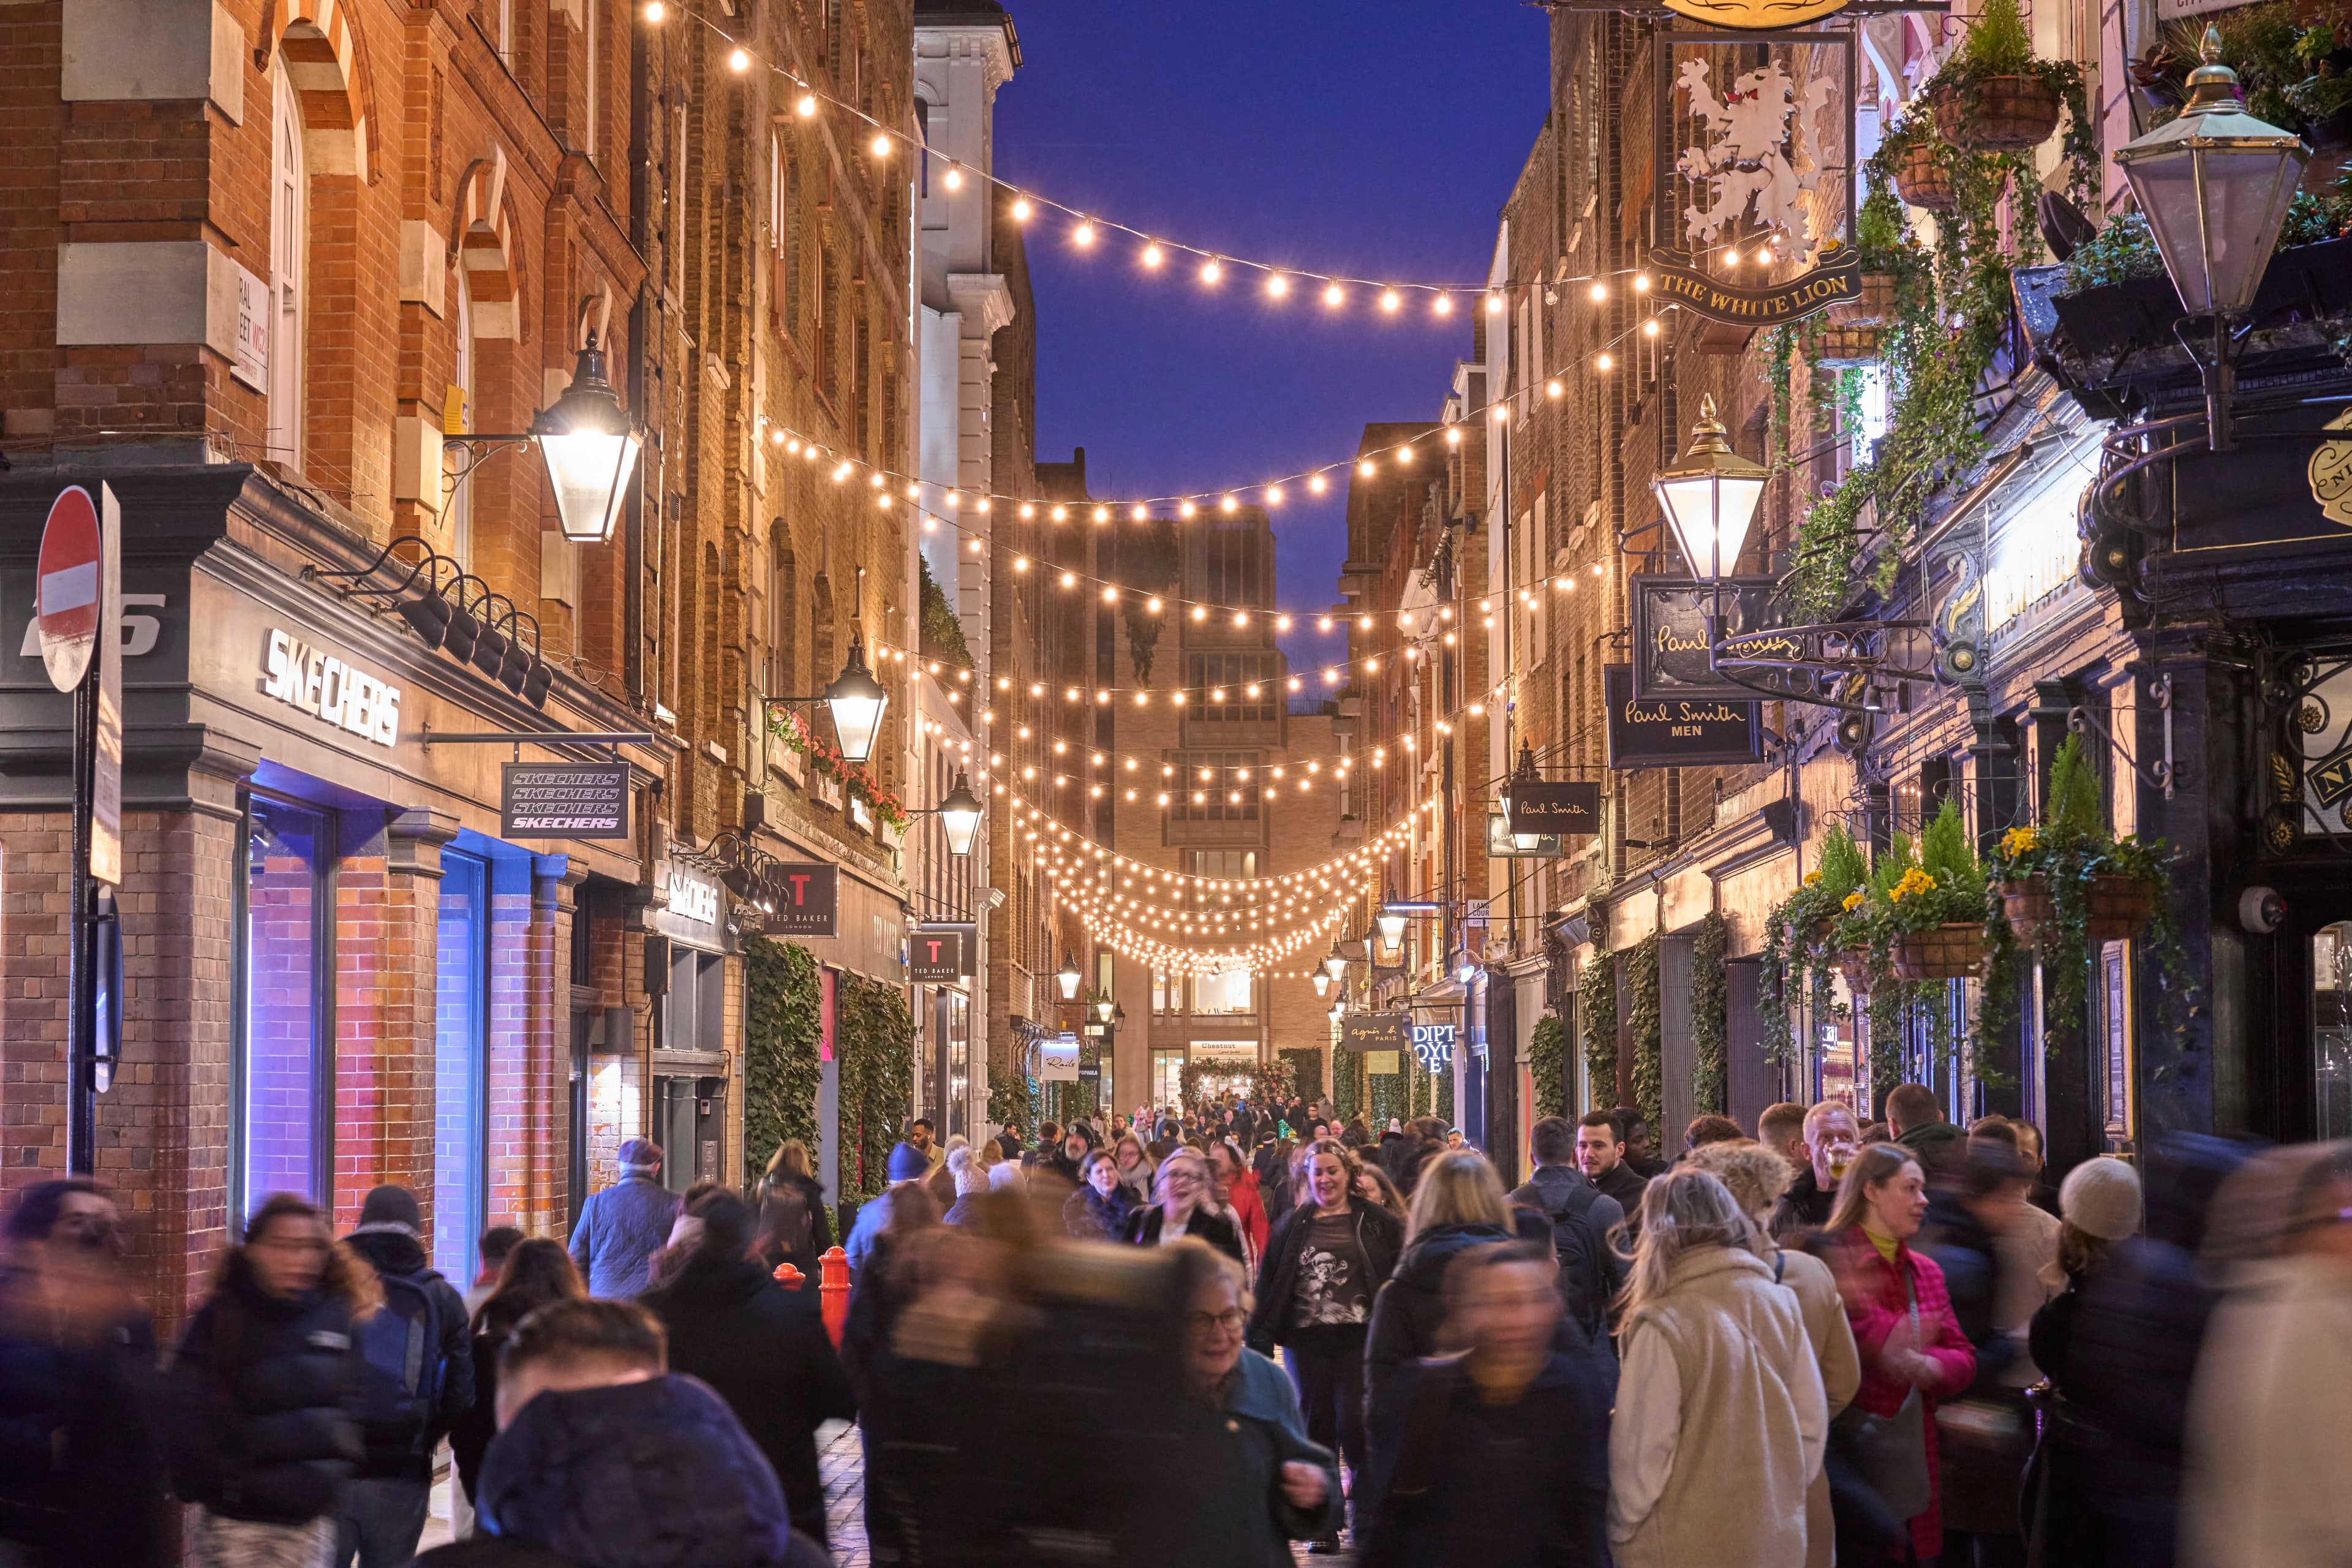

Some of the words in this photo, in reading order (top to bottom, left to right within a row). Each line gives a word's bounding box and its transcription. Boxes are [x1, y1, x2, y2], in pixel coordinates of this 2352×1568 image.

[1660, 274, 1707, 302] THE
[1709, 290, 1790, 317] WHITE
[1790, 276, 1849, 308] LION
[252, 321, 265, 356] WC2
[1657, 625, 1711, 652] Paul
[262, 627, 401, 748] SKECHERS
[1625, 700, 1672, 723] Paul
[1679, 702, 1746, 722] Smith
[1672, 725, 1702, 736] MEN
[512, 773, 620, 785] SKECHERS
[512, 788, 620, 799] SKECHERS
[511, 802, 620, 814] SKECHERS
[1521, 801, 1548, 814] Paul
[1551, 802, 1589, 814] Smith
[511, 817, 619, 829] SKECHERS
[789, 875, 810, 905] T
[927, 941, 941, 963] T
[1414, 1025, 1455, 1042] DIPT
[1046, 1056, 1076, 1069] Rails
